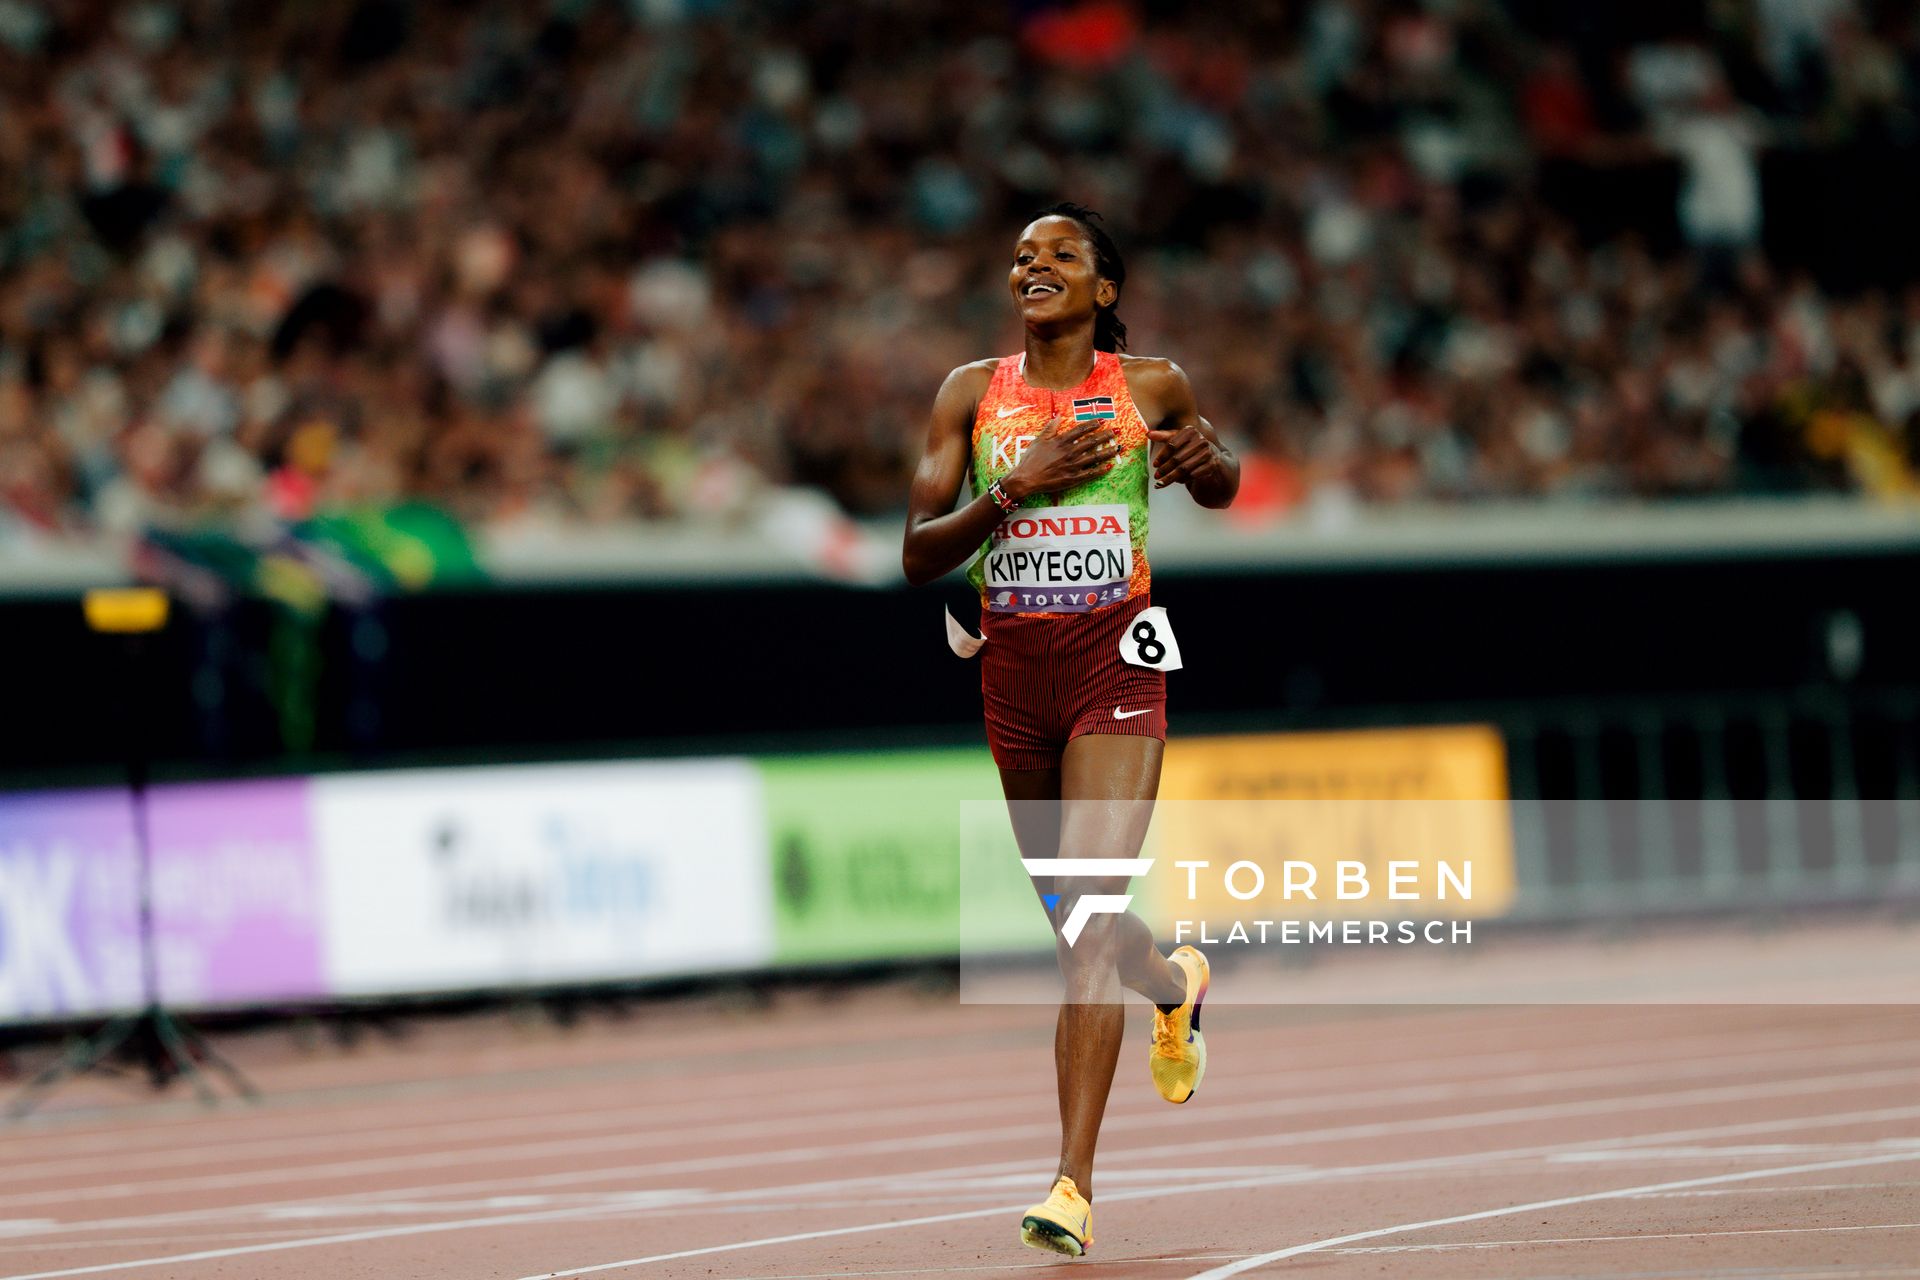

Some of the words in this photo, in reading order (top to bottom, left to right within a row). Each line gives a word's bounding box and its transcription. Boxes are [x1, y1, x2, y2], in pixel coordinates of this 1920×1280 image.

[994, 516, 1125, 539] HONDA
[991, 549, 1125, 582] KIPYEGON
[1132, 620, 1166, 664] 8
